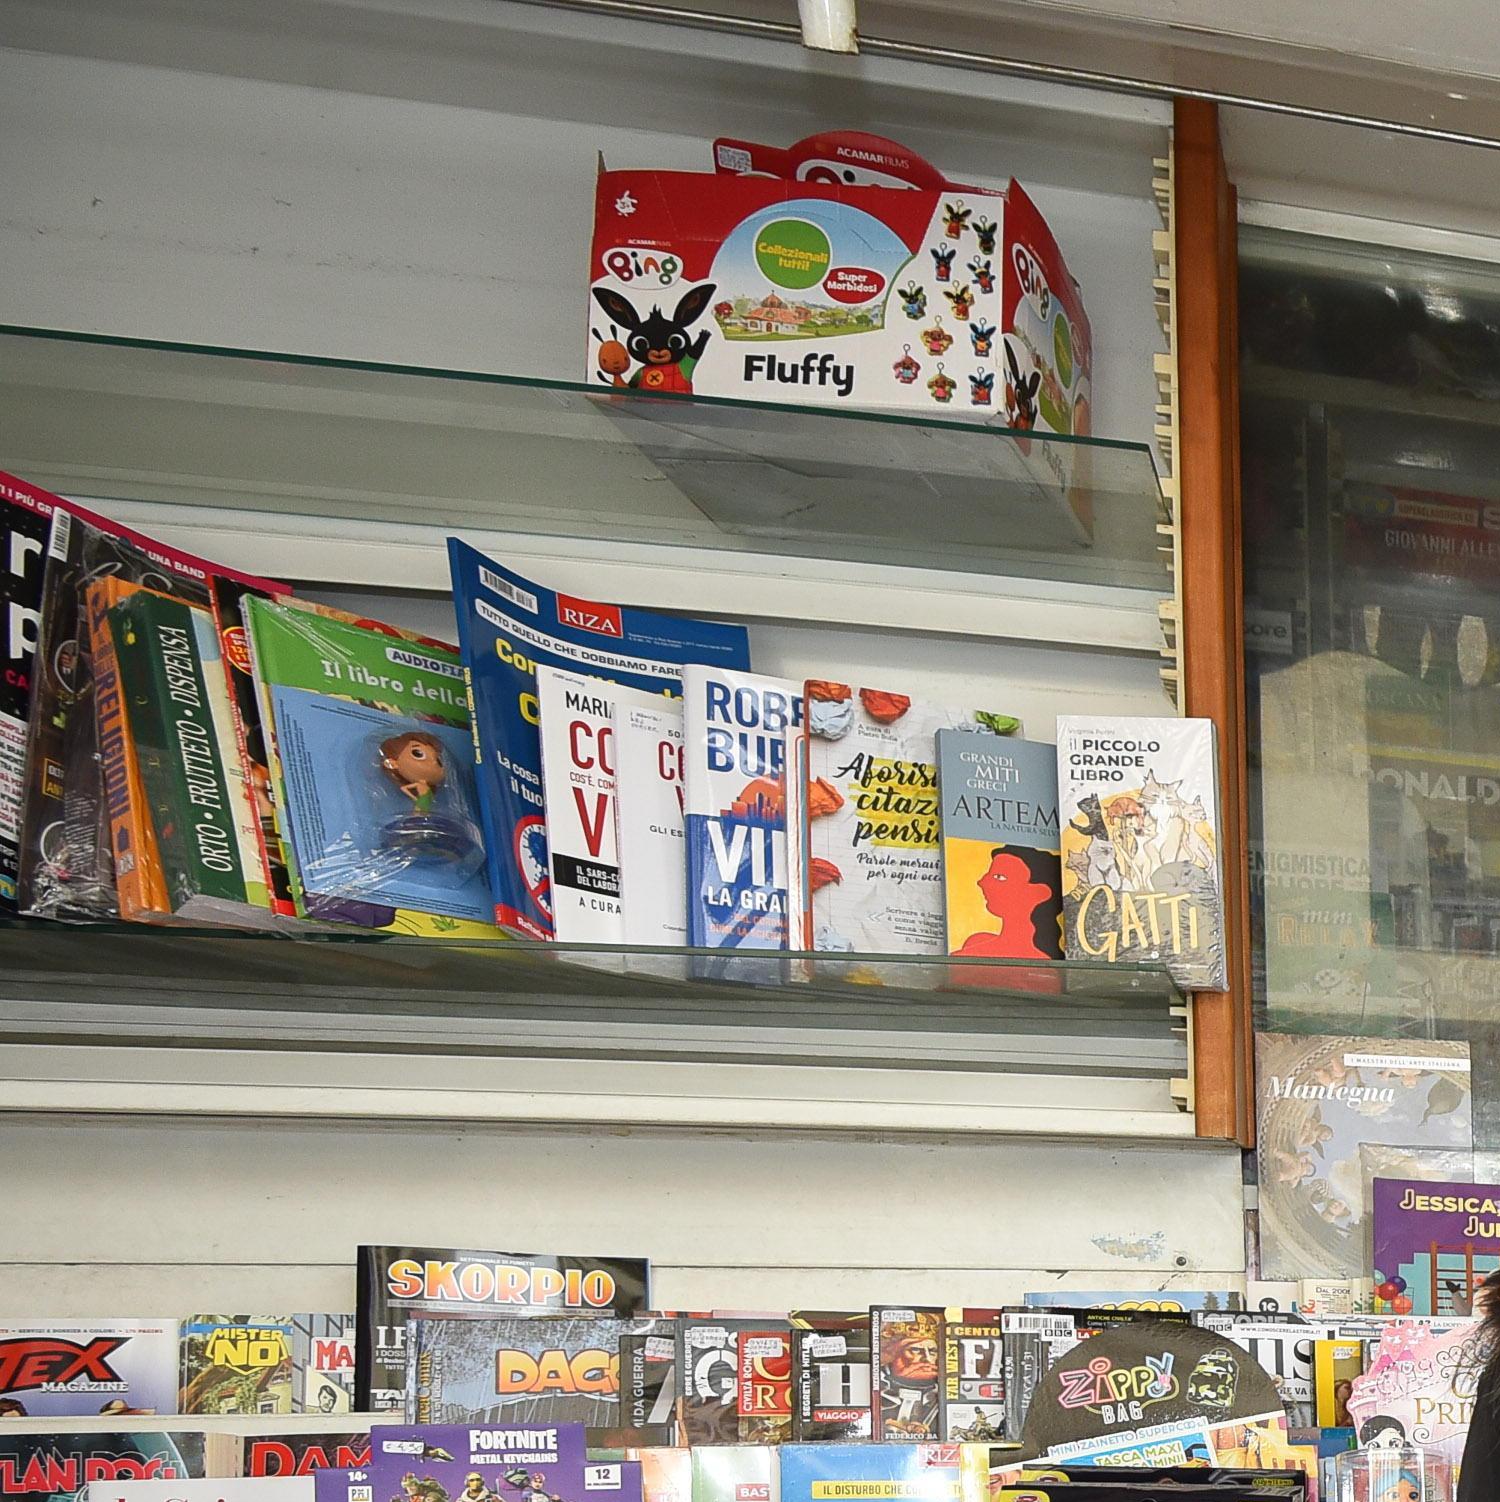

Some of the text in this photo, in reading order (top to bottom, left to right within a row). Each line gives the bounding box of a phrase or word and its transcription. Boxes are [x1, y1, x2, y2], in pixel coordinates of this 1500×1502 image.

[607, 250, 678, 282] Bing
[743, 355, 854, 396] Fluffy
[563, 609, 616, 632] RIZA
[349, 666, 468, 707] libro della
[171, 625, 232, 872] ORTO FRUTTETO DISPENSA
[1081, 738, 1161, 754] PICCOLO
[975, 766, 1020, 784] MITI
[1070, 767, 1125, 783] LIBRO
[857, 853, 895, 868] Parole
[1077, 884, 1200, 961] GATTI
[1267, 1077, 1394, 1105] Mantegna
[387, 1259, 615, 1306] SKORPIO
[213, 1327, 283, 1343] MISTER
[214, 1339, 279, 1368] NO
[1104, 1404, 1144, 1423] BAG
[470, 1429, 557, 1451] FORTNITE
[470, 1452, 557, 1463] METAL KEYCHAINS
